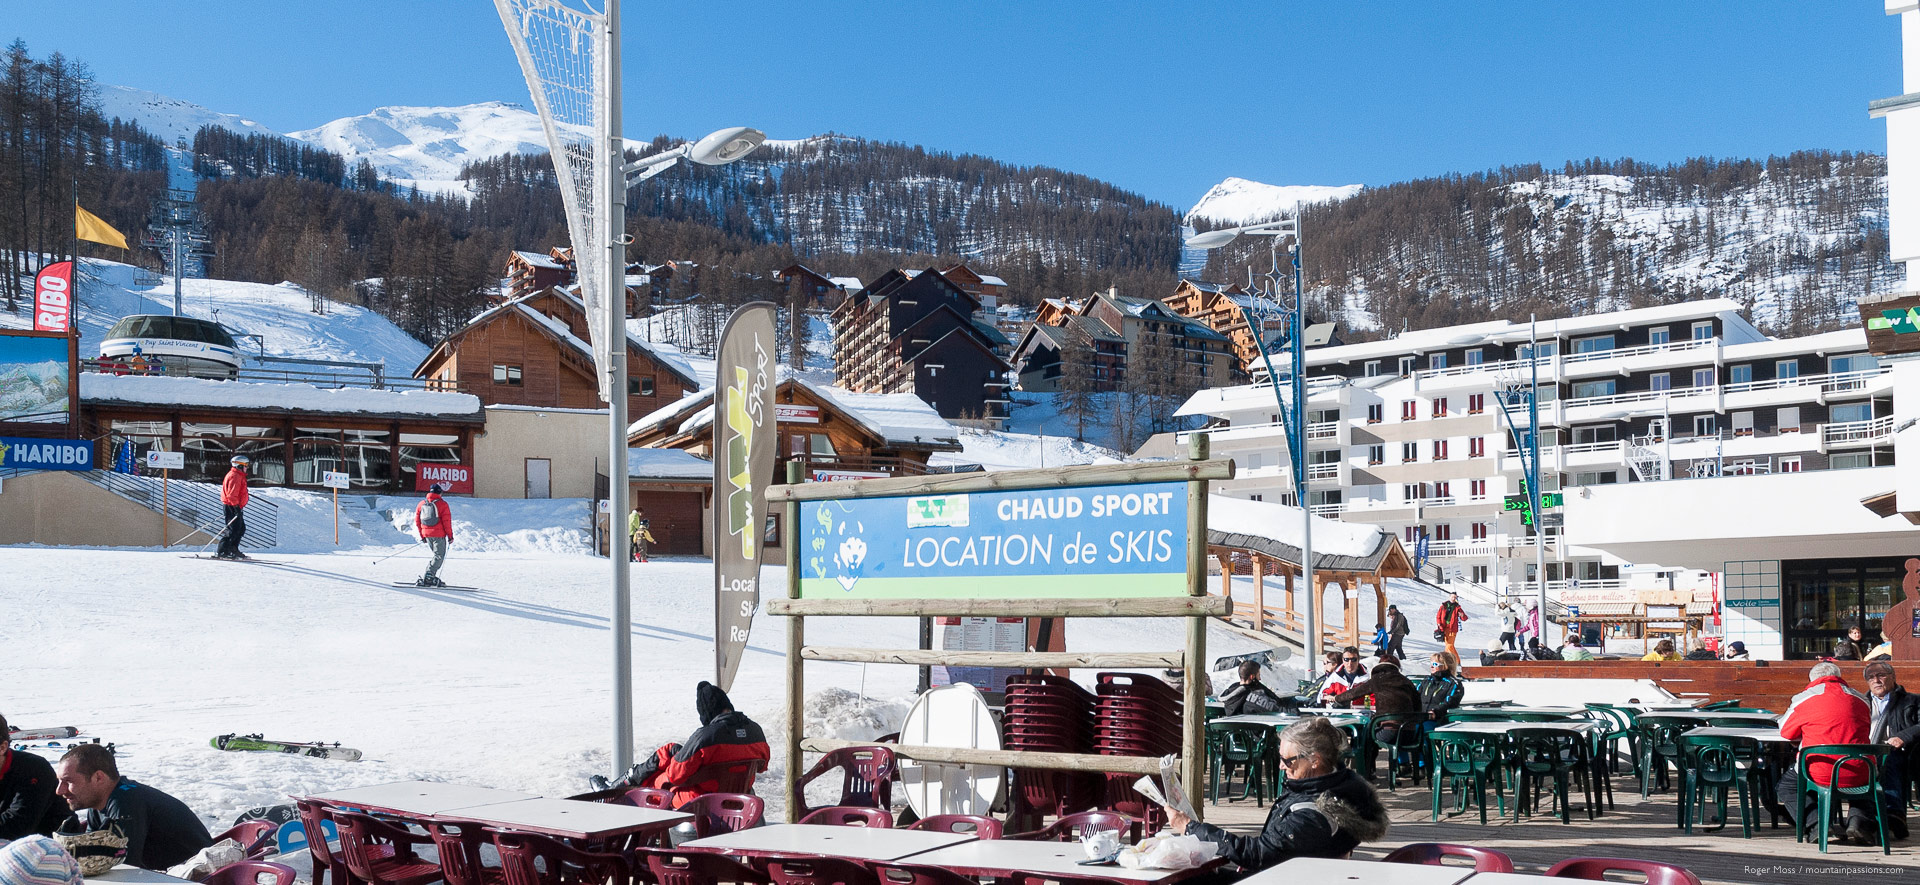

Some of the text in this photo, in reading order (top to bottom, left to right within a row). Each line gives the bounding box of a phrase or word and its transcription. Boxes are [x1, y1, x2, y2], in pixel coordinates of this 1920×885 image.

[38, 275, 67, 332] RIBO
[145, 340, 156, 348] Puy
[749, 331, 769, 428] SPORT
[14, 443, 89, 465] HARIBO
[422, 466, 468, 482] HARIBO
[997, 492, 1173, 521] CHAUD SPORT
[903, 529, 1173, 568] LOCATION de SKIS
